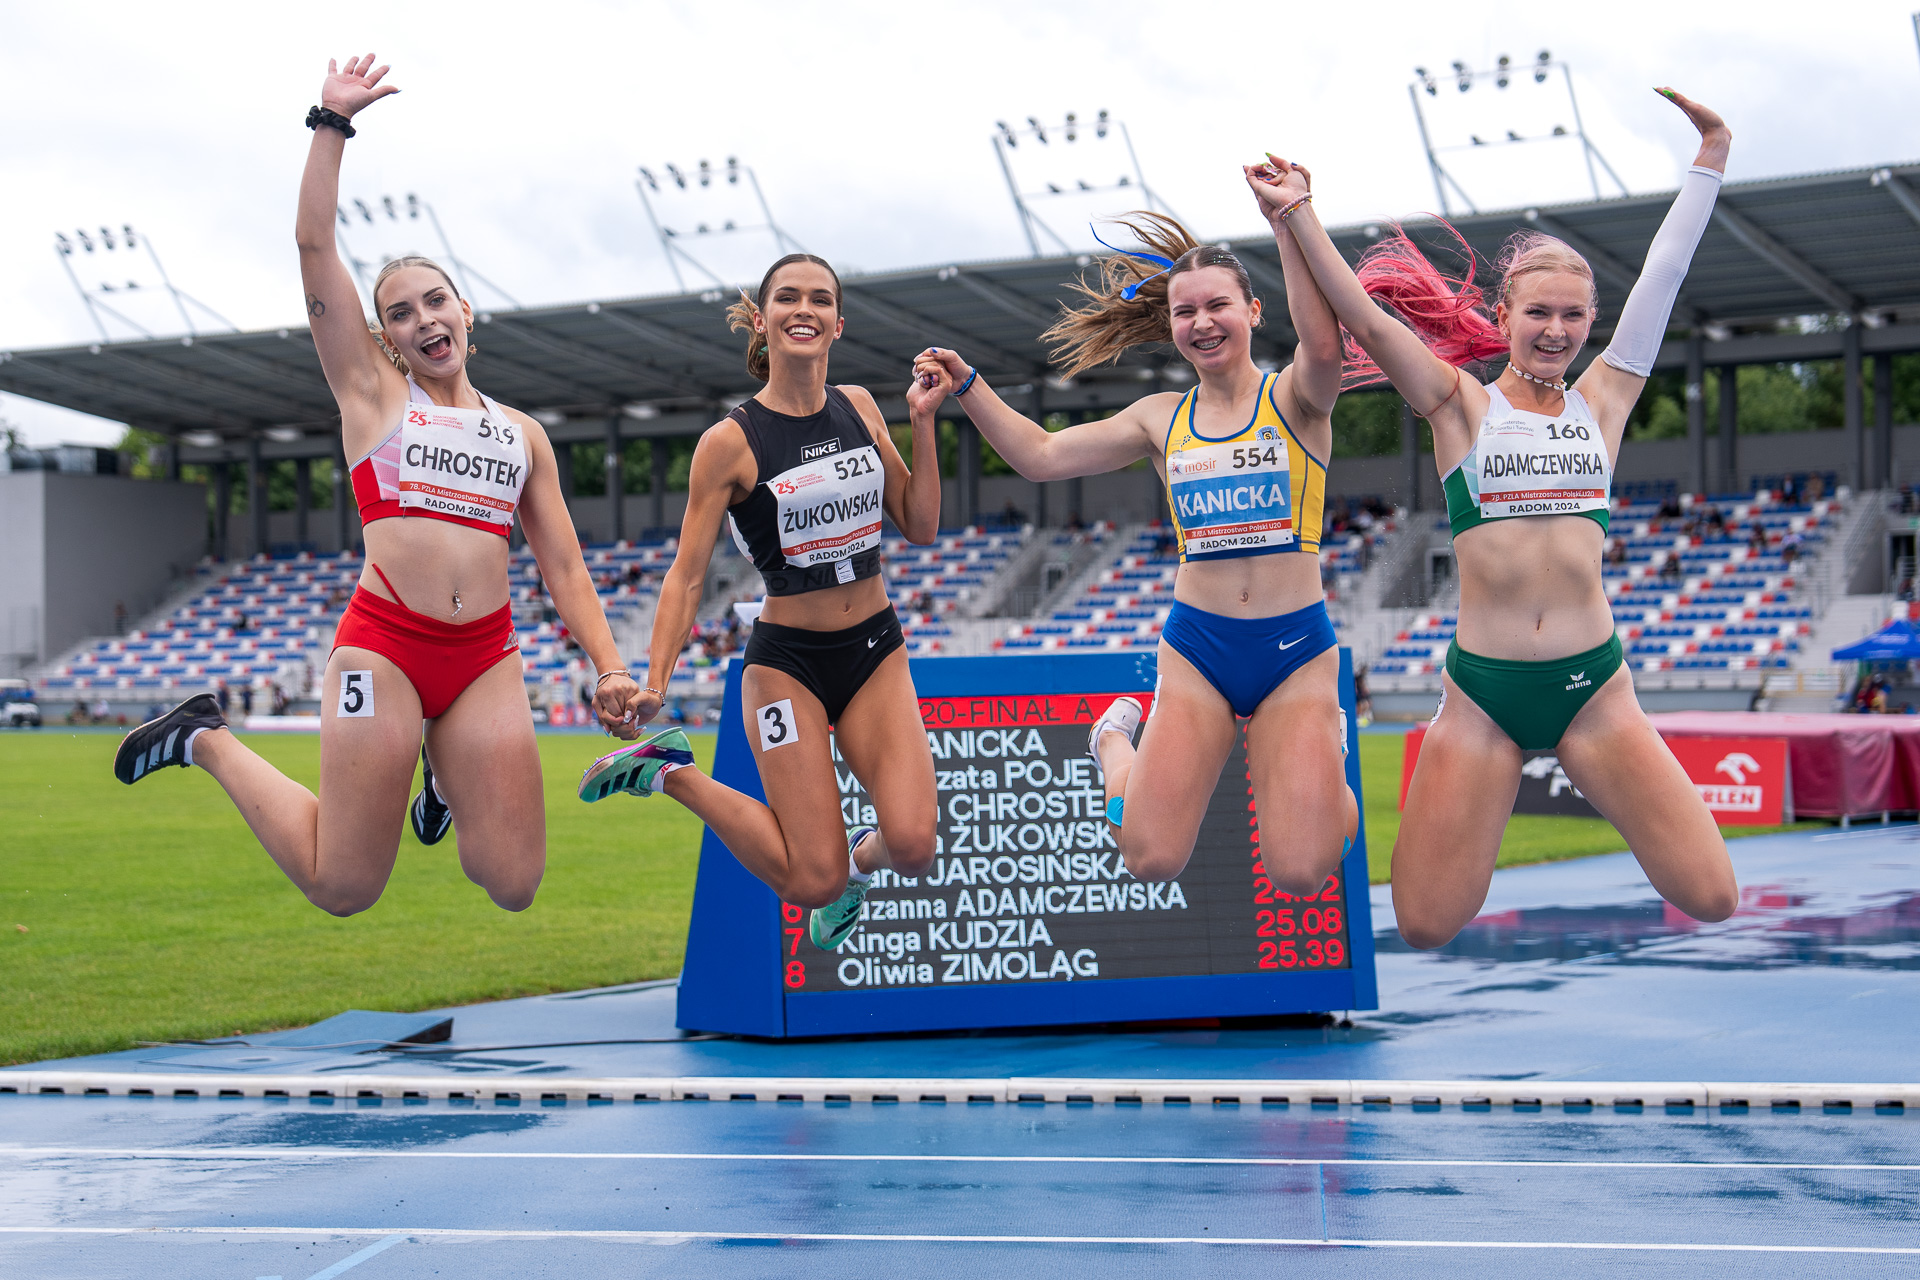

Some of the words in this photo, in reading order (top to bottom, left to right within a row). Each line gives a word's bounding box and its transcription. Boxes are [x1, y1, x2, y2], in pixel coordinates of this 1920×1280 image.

[478, 418, 515, 445] 519
[1546, 424, 1590, 441] 160
[805, 442, 838, 458] NIKE
[1232, 446, 1278, 469] 554
[406, 444, 521, 488] CHROSTEK
[834, 454, 875, 480] 521
[1185, 458, 1216, 473] mosir
[1483, 453, 1603, 478] ADAMCZEWSKA
[421, 485, 436, 494] PZLA
[436, 488, 479, 502] Mistrzostwa
[480, 497, 497, 507] Polski
[497, 501, 508, 510] U20
[425, 497, 465, 513] RADOM
[468, 507, 492, 519] 2024
[1177, 483, 1285, 518] KANICKA
[1503, 492, 1520, 500] PZLA
[1521, 491, 1562, 499] Mistrzostwa
[1509, 503, 1553, 514] RADOM
[1554, 502, 1581, 511] 2024
[783, 489, 879, 534] ŻUKOWSKA
[803, 543, 817, 551] PZLA
[852, 529, 866, 539] Polski
[866, 525, 876, 534] U20
[1207, 526, 1248, 536] Mistrzostwa
[1249, 522, 1268, 532] Polski
[1269, 521, 1282, 530] U20
[809, 549, 847, 562] RADOM
[847, 541, 866, 553] 2024
[1200, 538, 1238, 550] RADOM
[1240, 535, 1267, 545] 2024
[344, 674, 364, 713] 5
[1565, 679, 1592, 691] erima
[919, 698, 1061, 725] 20-FINAŁ
[1074, 697, 1095, 721] A
[765, 706, 787, 743] 3
[927, 728, 1049, 759] ANICKA
[948, 789, 1106, 822] CHROSTE
[1702, 791, 1755, 804] RLEN
[950, 820, 1117, 854] ŻUKOWSK
[926, 849, 1136, 887] JAROSIŃSKA
[782, 901, 804, 924] 6
[858, 898, 947, 922] uzanna
[954, 881, 1188, 918] ADAMCZEWSKA
[784, 928, 805, 956] 7
[836, 925, 922, 961] Kinga
[928, 918, 1053, 951] KUDZIA
[1255, 907, 1343, 937] 25.08
[785, 960, 806, 989] 8
[837, 956, 934, 987] Oliwia
[940, 948, 1099, 983] ZIMOLĄG
[1257, 938, 1344, 969] 25.39
